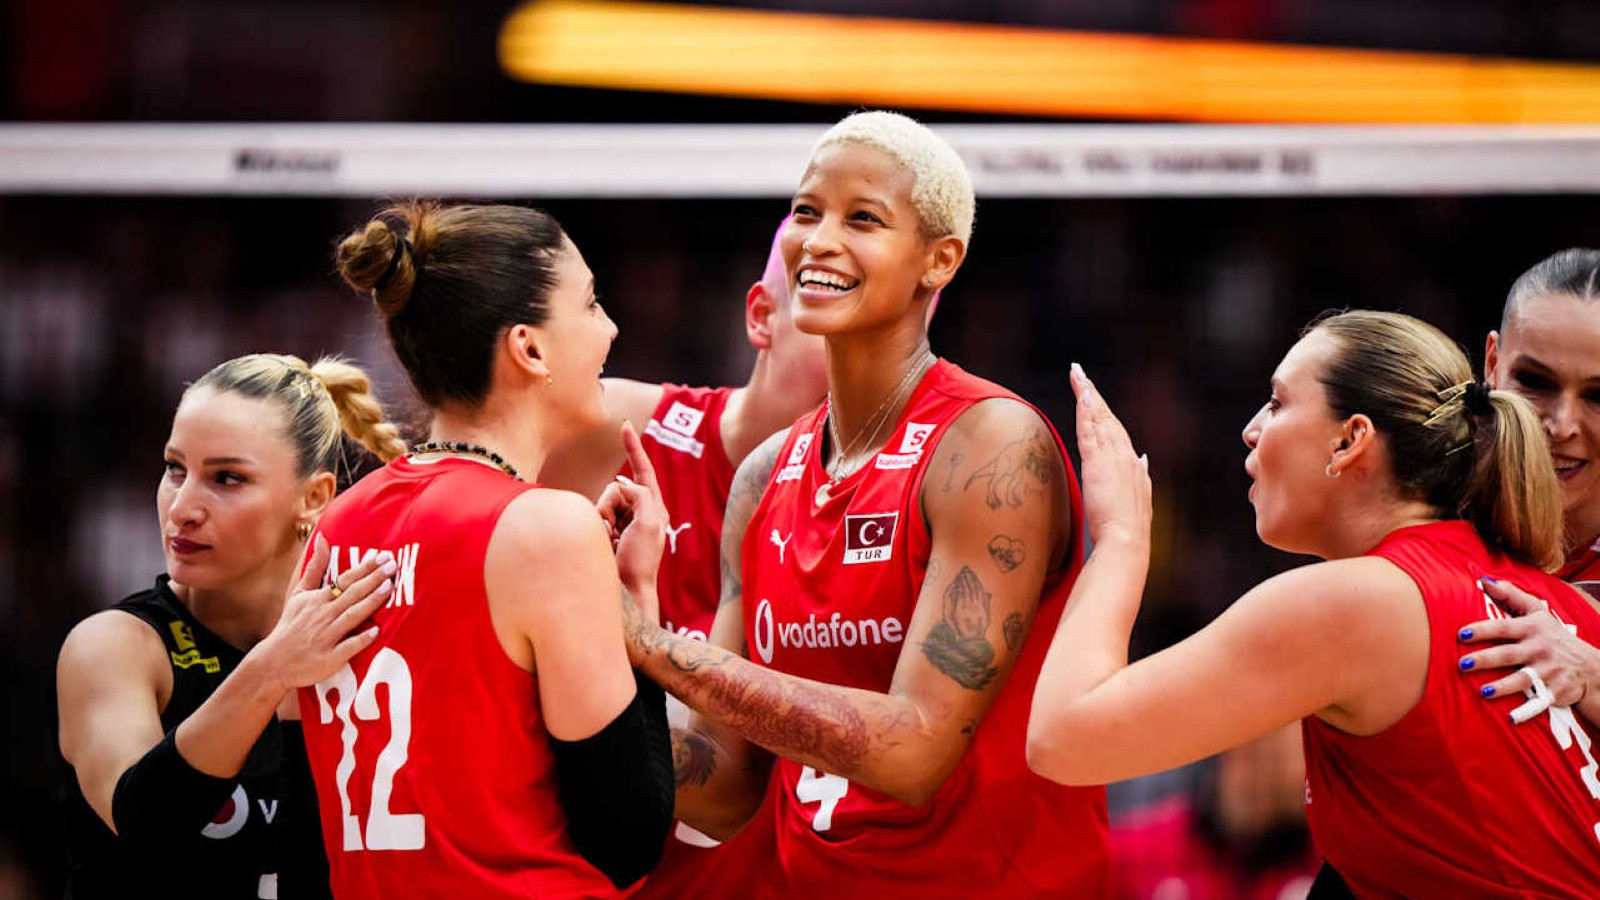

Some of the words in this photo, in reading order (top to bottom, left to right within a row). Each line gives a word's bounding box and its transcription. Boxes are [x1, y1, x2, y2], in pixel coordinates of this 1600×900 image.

[910, 430, 927, 446] S
[854, 549, 882, 560] TUR
[777, 612, 903, 648] vodafone
[315, 647, 426, 852] 22
